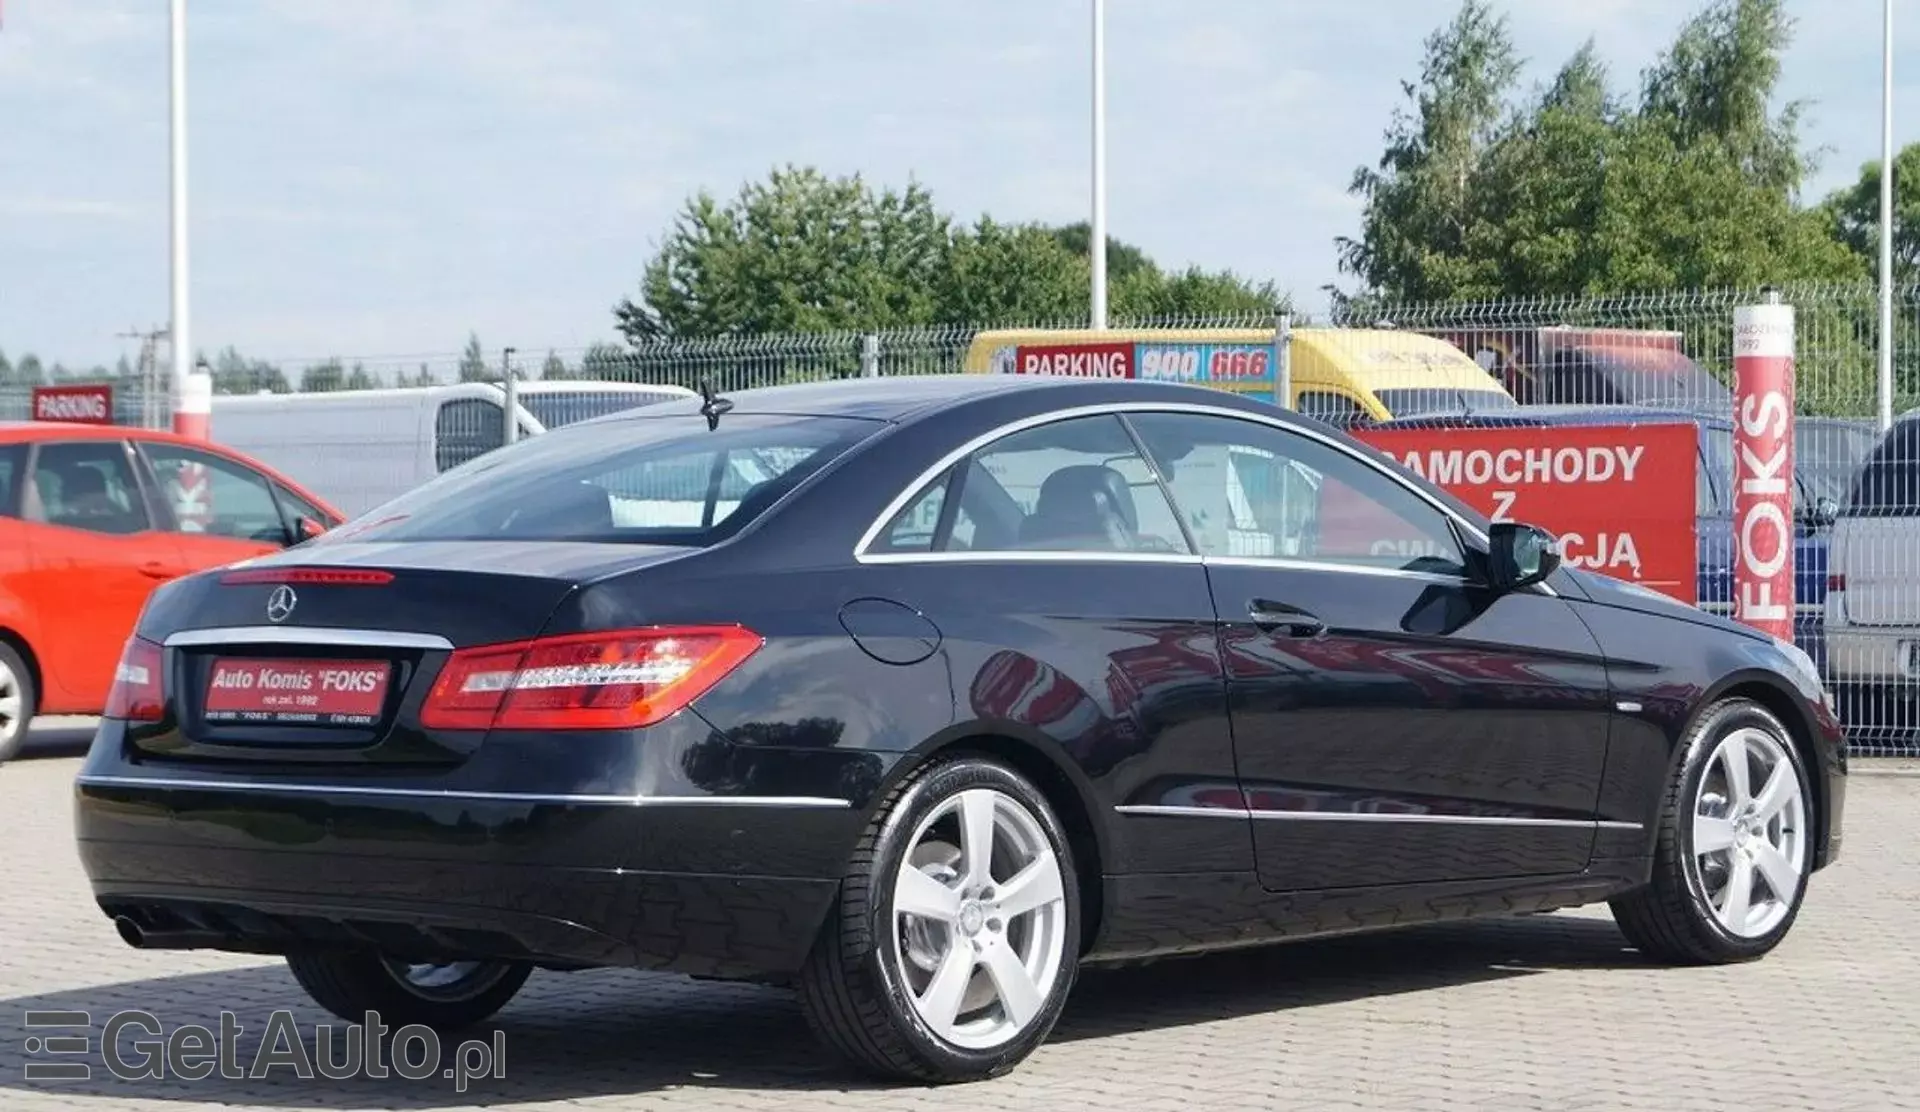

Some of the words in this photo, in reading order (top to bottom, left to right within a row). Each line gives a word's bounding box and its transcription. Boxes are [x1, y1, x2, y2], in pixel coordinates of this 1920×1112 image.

[1025, 352, 1126, 378] PARKING
[1142, 350, 1200, 377] 900
[38, 393, 106, 418] PARKING
[1382, 446, 1644, 485] AMOCHODY
[1491, 491, 1516, 523] Z
[1741, 390, 1788, 621] FOKS
[212, 668, 253, 688] Auto
[257, 668, 313, 690] Komis
[318, 669, 384, 692] "FOKS"
